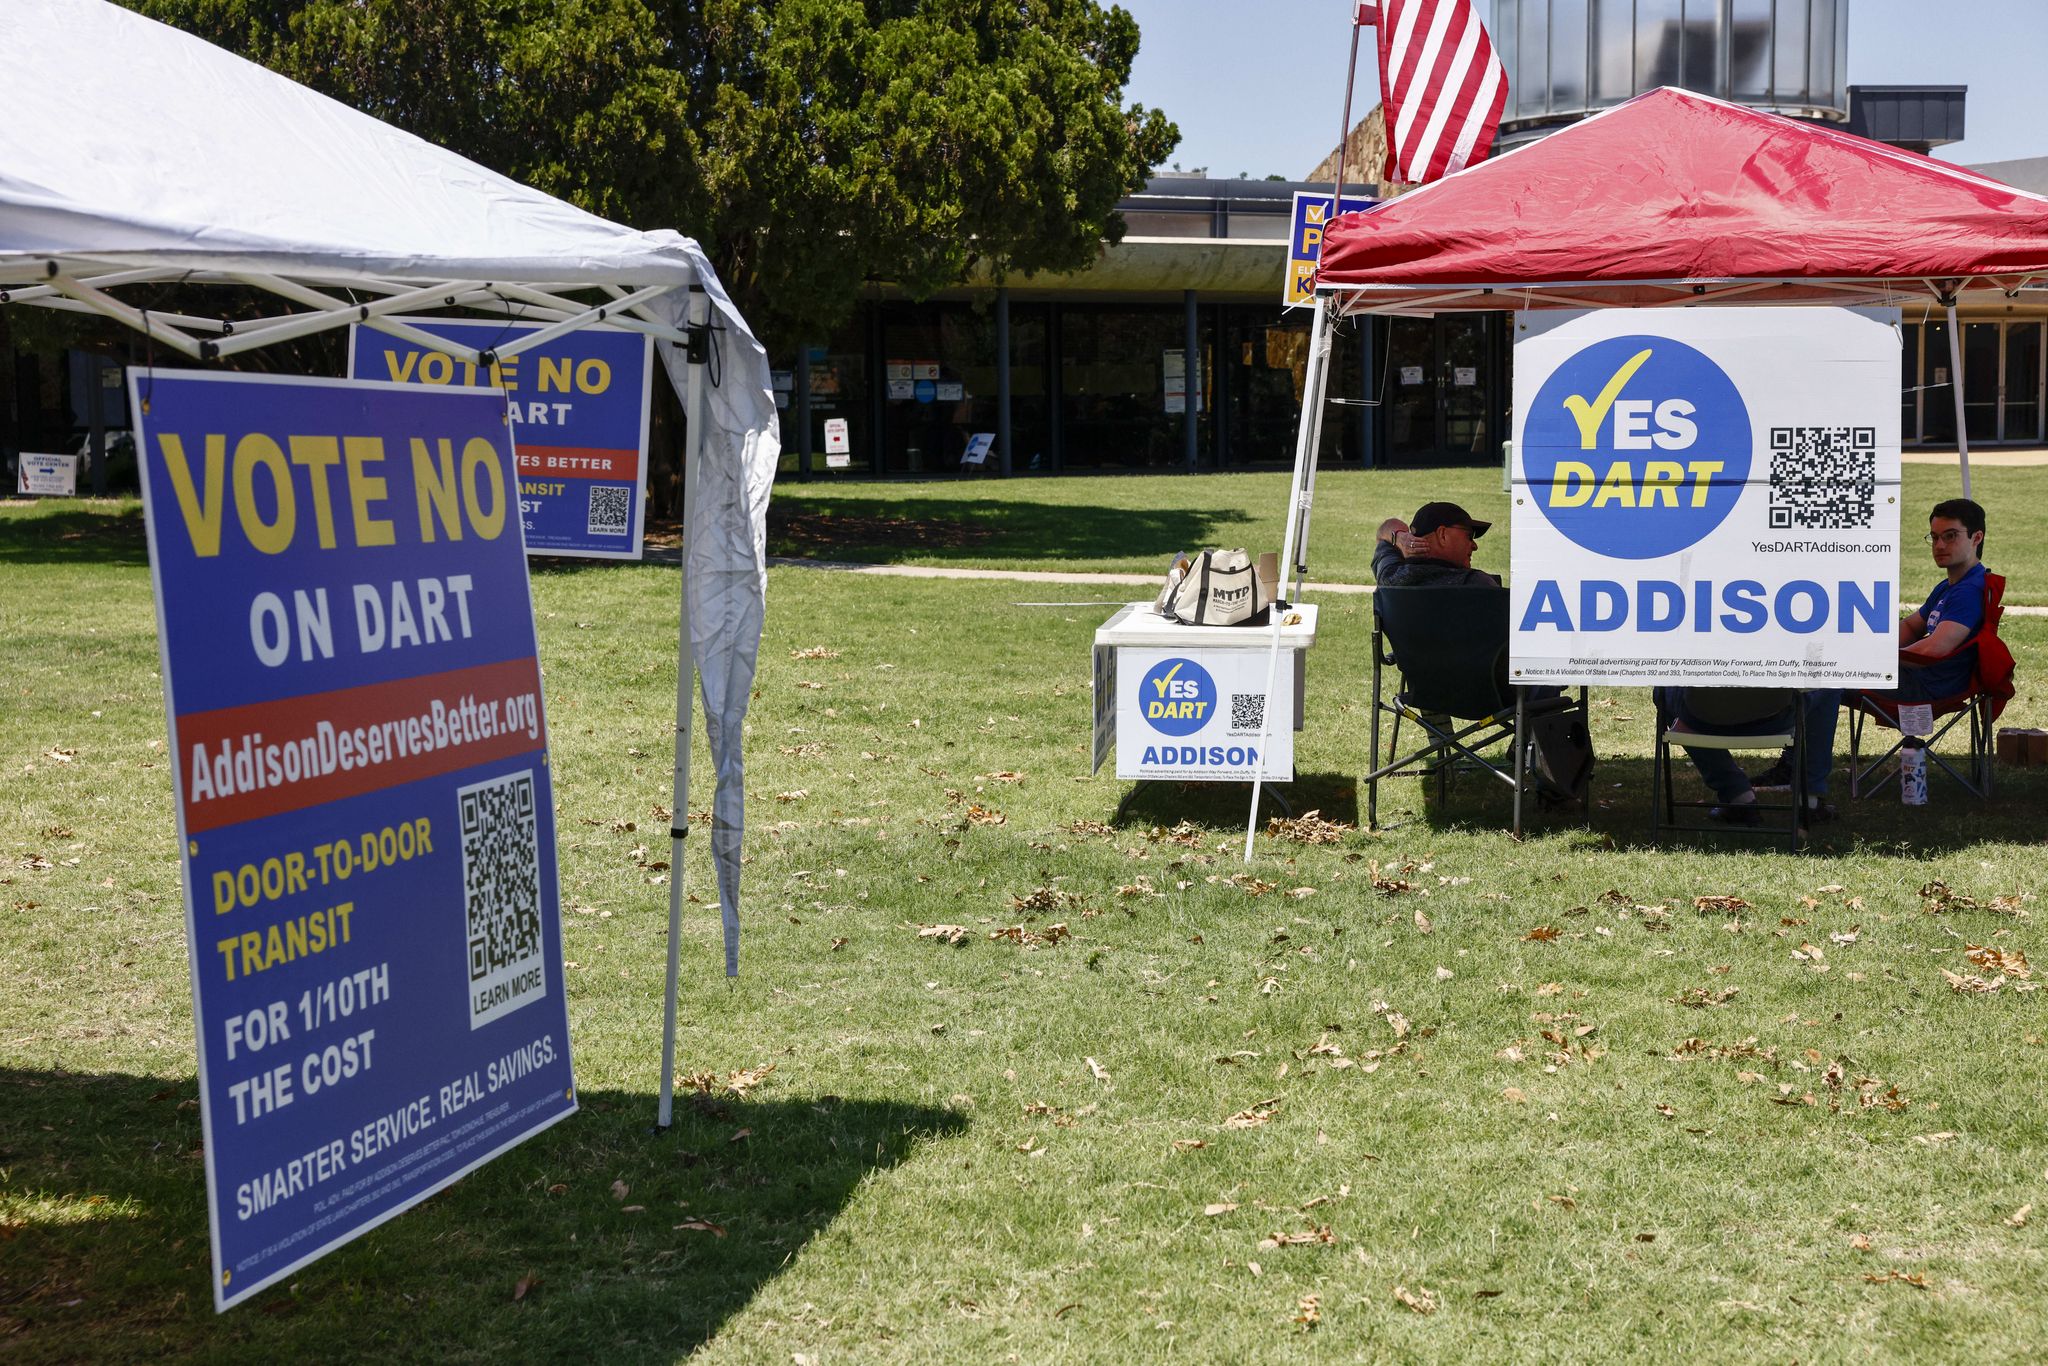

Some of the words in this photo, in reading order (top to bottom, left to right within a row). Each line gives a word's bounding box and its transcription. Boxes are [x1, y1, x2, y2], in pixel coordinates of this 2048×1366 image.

[384, 350, 519, 390] VOTE
[537, 356, 611, 395] NO
[509, 401, 572, 425] ART
[1563, 348, 1698, 451] YES
[547, 457, 612, 471] BETTER
[1548, 461, 1725, 508] DART
[157, 432, 395, 557] VOTE
[410, 437, 506, 543] NO
[519, 482, 565, 496] ANSIT
[1752, 541, 1891, 554] YesDARTAddison.com
[1213, 585, 1249, 601] MTTP
[1519, 580, 1890, 634] ADDISON
[250, 587, 334, 668] ON
[353, 574, 473, 653] DART
[1153, 663, 1199, 699] YES
[1569, 658, 1598, 666] Political
[1600, 658, 1640, 667] advertising
[1641, 658, 1658, 667] paid
[1670, 659, 1679, 667] by
[1713, 659, 1729, 667] Way
[1731, 659, 1763, 667] Forward,
[1778, 670, 1790, 678] Sign
[1148, 702, 1207, 719] DART
[191, 692, 538, 803] AddisonDeservesBetter.org
[1141, 746, 1265, 766] ADDISON
[212, 817, 433, 914] DOOR-TO-DOOR
[218, 902, 354, 981] TRANSIT
[225, 1000, 290, 1060] FOR
[299, 963, 389, 1033] 1/10TH
[473, 986, 509, 1015] LEARN
[512, 967, 542, 1000] MORE
[229, 1063, 293, 1125] THE
[302, 1029, 375, 1095] COST
[237, 1139, 346, 1221] SMARTER
[351, 1095, 436, 1164] SERVICE.
[440, 1073, 484, 1119] REAL
[487, 1034, 557, 1093] SAVINGS.
